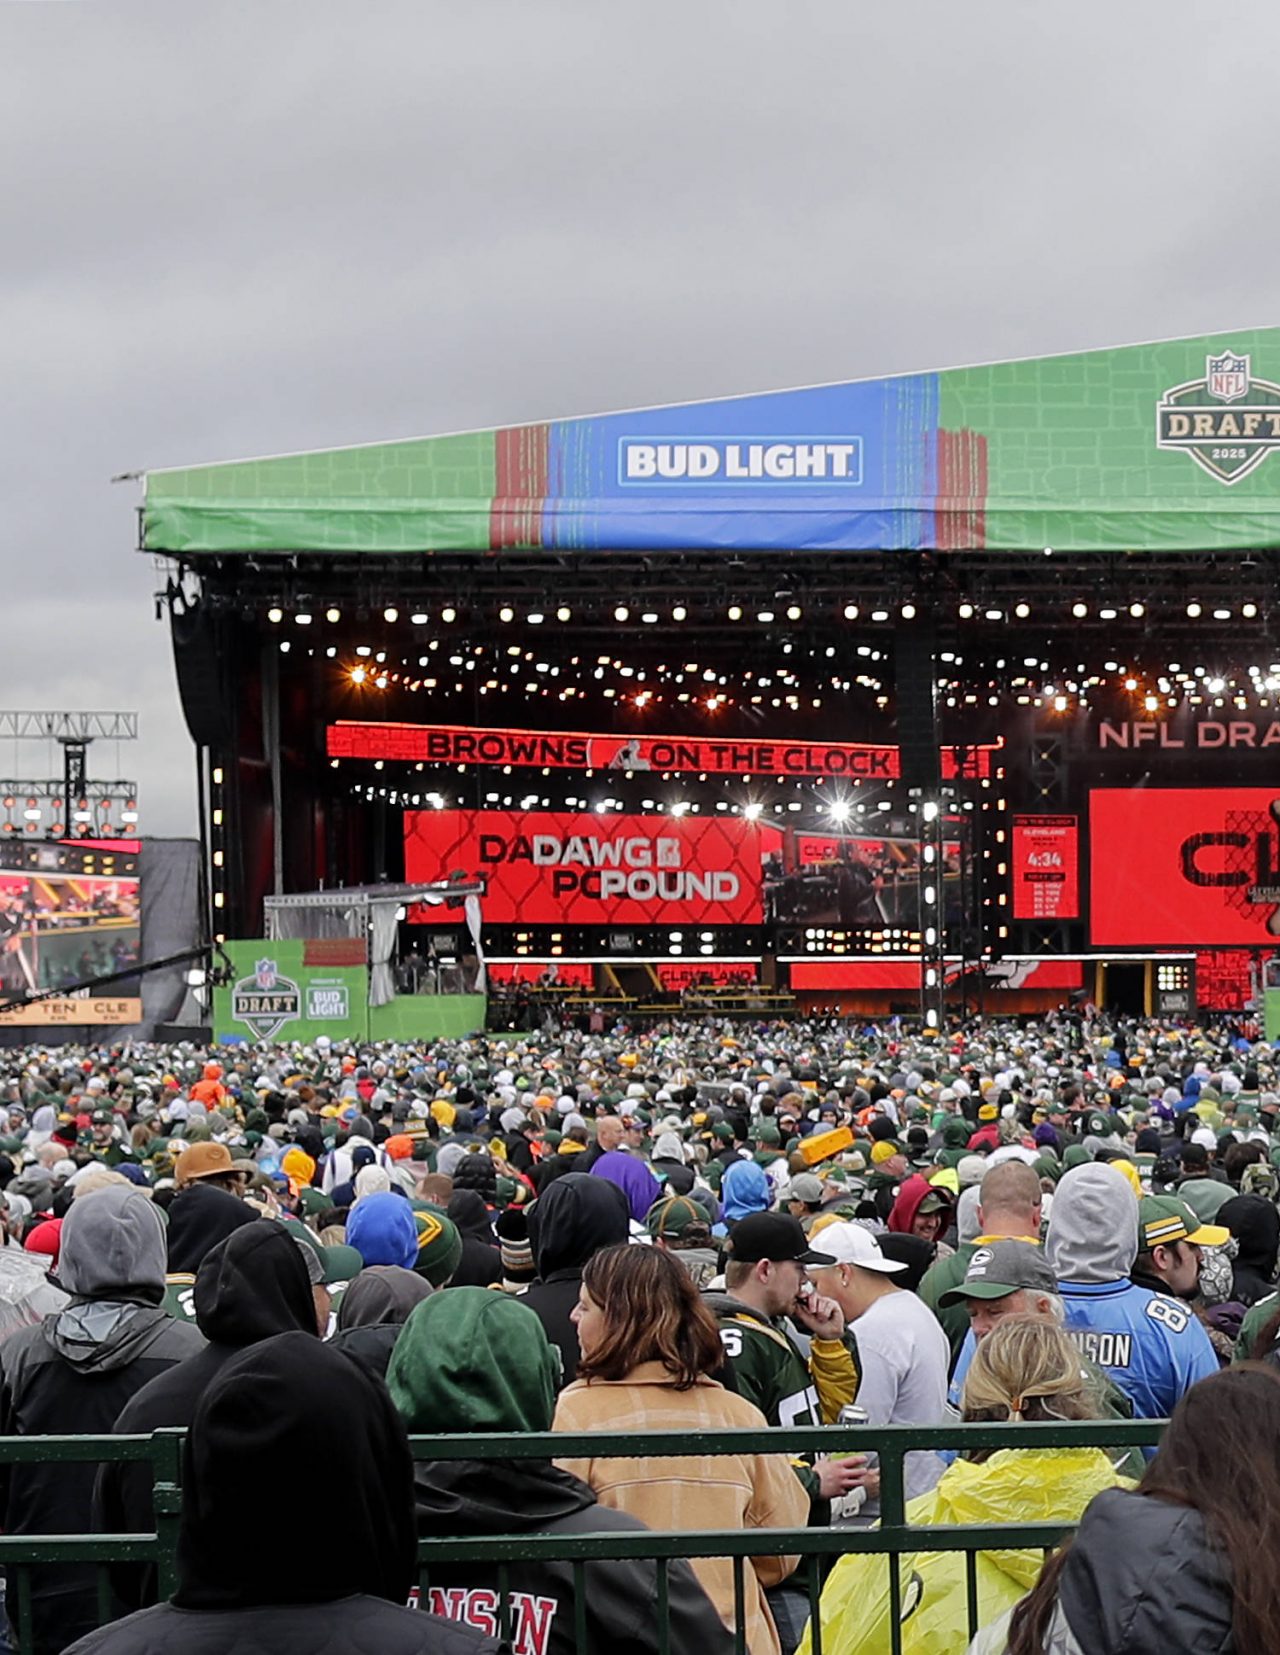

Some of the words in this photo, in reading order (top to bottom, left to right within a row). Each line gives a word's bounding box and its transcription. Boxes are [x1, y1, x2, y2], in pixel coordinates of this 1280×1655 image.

[1213, 373, 1244, 394] NFL
[627, 445, 720, 477] BUD
[726, 444, 854, 477] LIGHT
[1212, 447, 1247, 459] 2025
[1100, 722, 1184, 747] NFL
[427, 732, 587, 764] BROWNS
[650, 743, 703, 770] ON
[709, 745, 775, 770] THE
[782, 748, 891, 774] CLOCK
[533, 834, 650, 867] DAWG
[1028, 851, 1062, 867] 4:34
[600, 870, 739, 900] POUND
[238, 998, 296, 1012] DRAFT
[313, 991, 340, 1002] BUD
[41, 1003, 76, 1013] TEN
[94, 1002, 128, 1013] CLE
[310, 1003, 345, 1016] LIGHT
